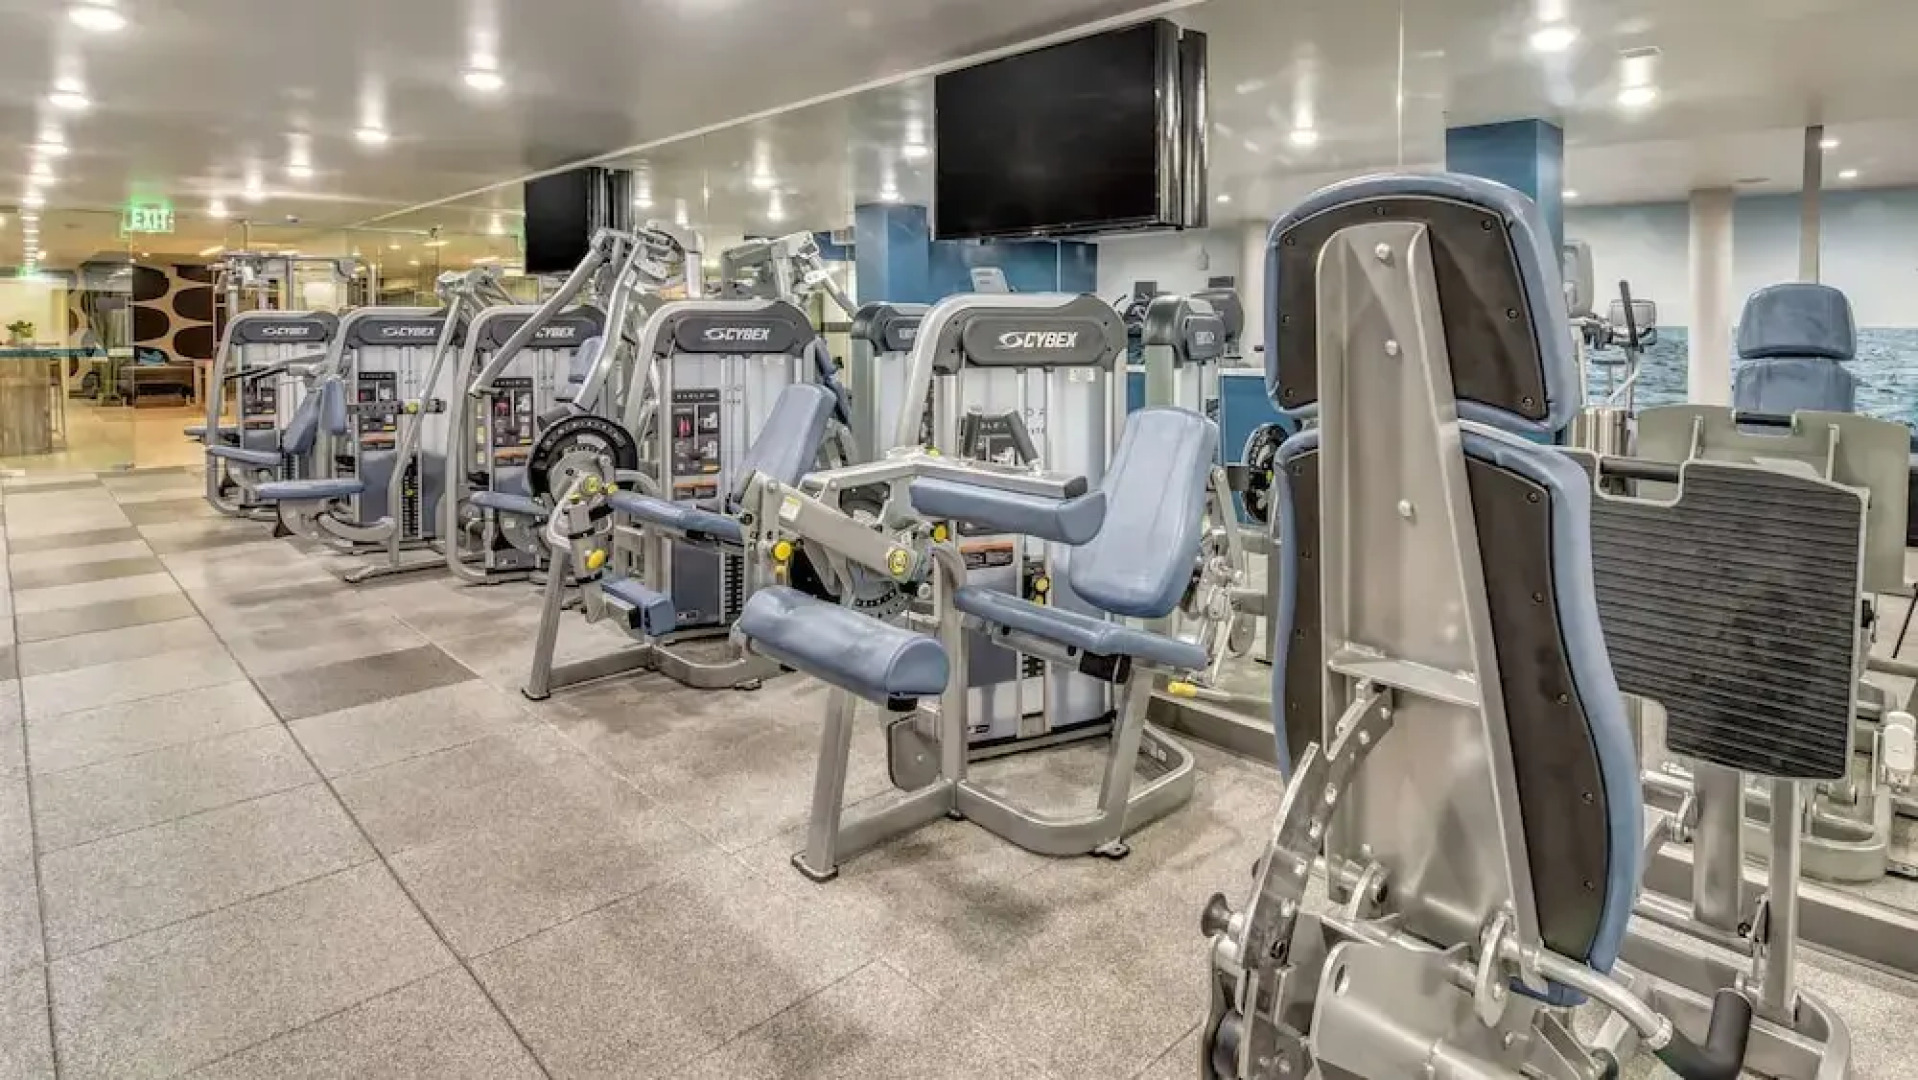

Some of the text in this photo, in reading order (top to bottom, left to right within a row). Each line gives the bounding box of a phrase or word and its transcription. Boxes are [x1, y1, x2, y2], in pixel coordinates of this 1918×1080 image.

[132, 208, 170, 230] EXIT
[724, 327, 771, 341] CYBEX
[1024, 331, 1079, 348] CYBEX
